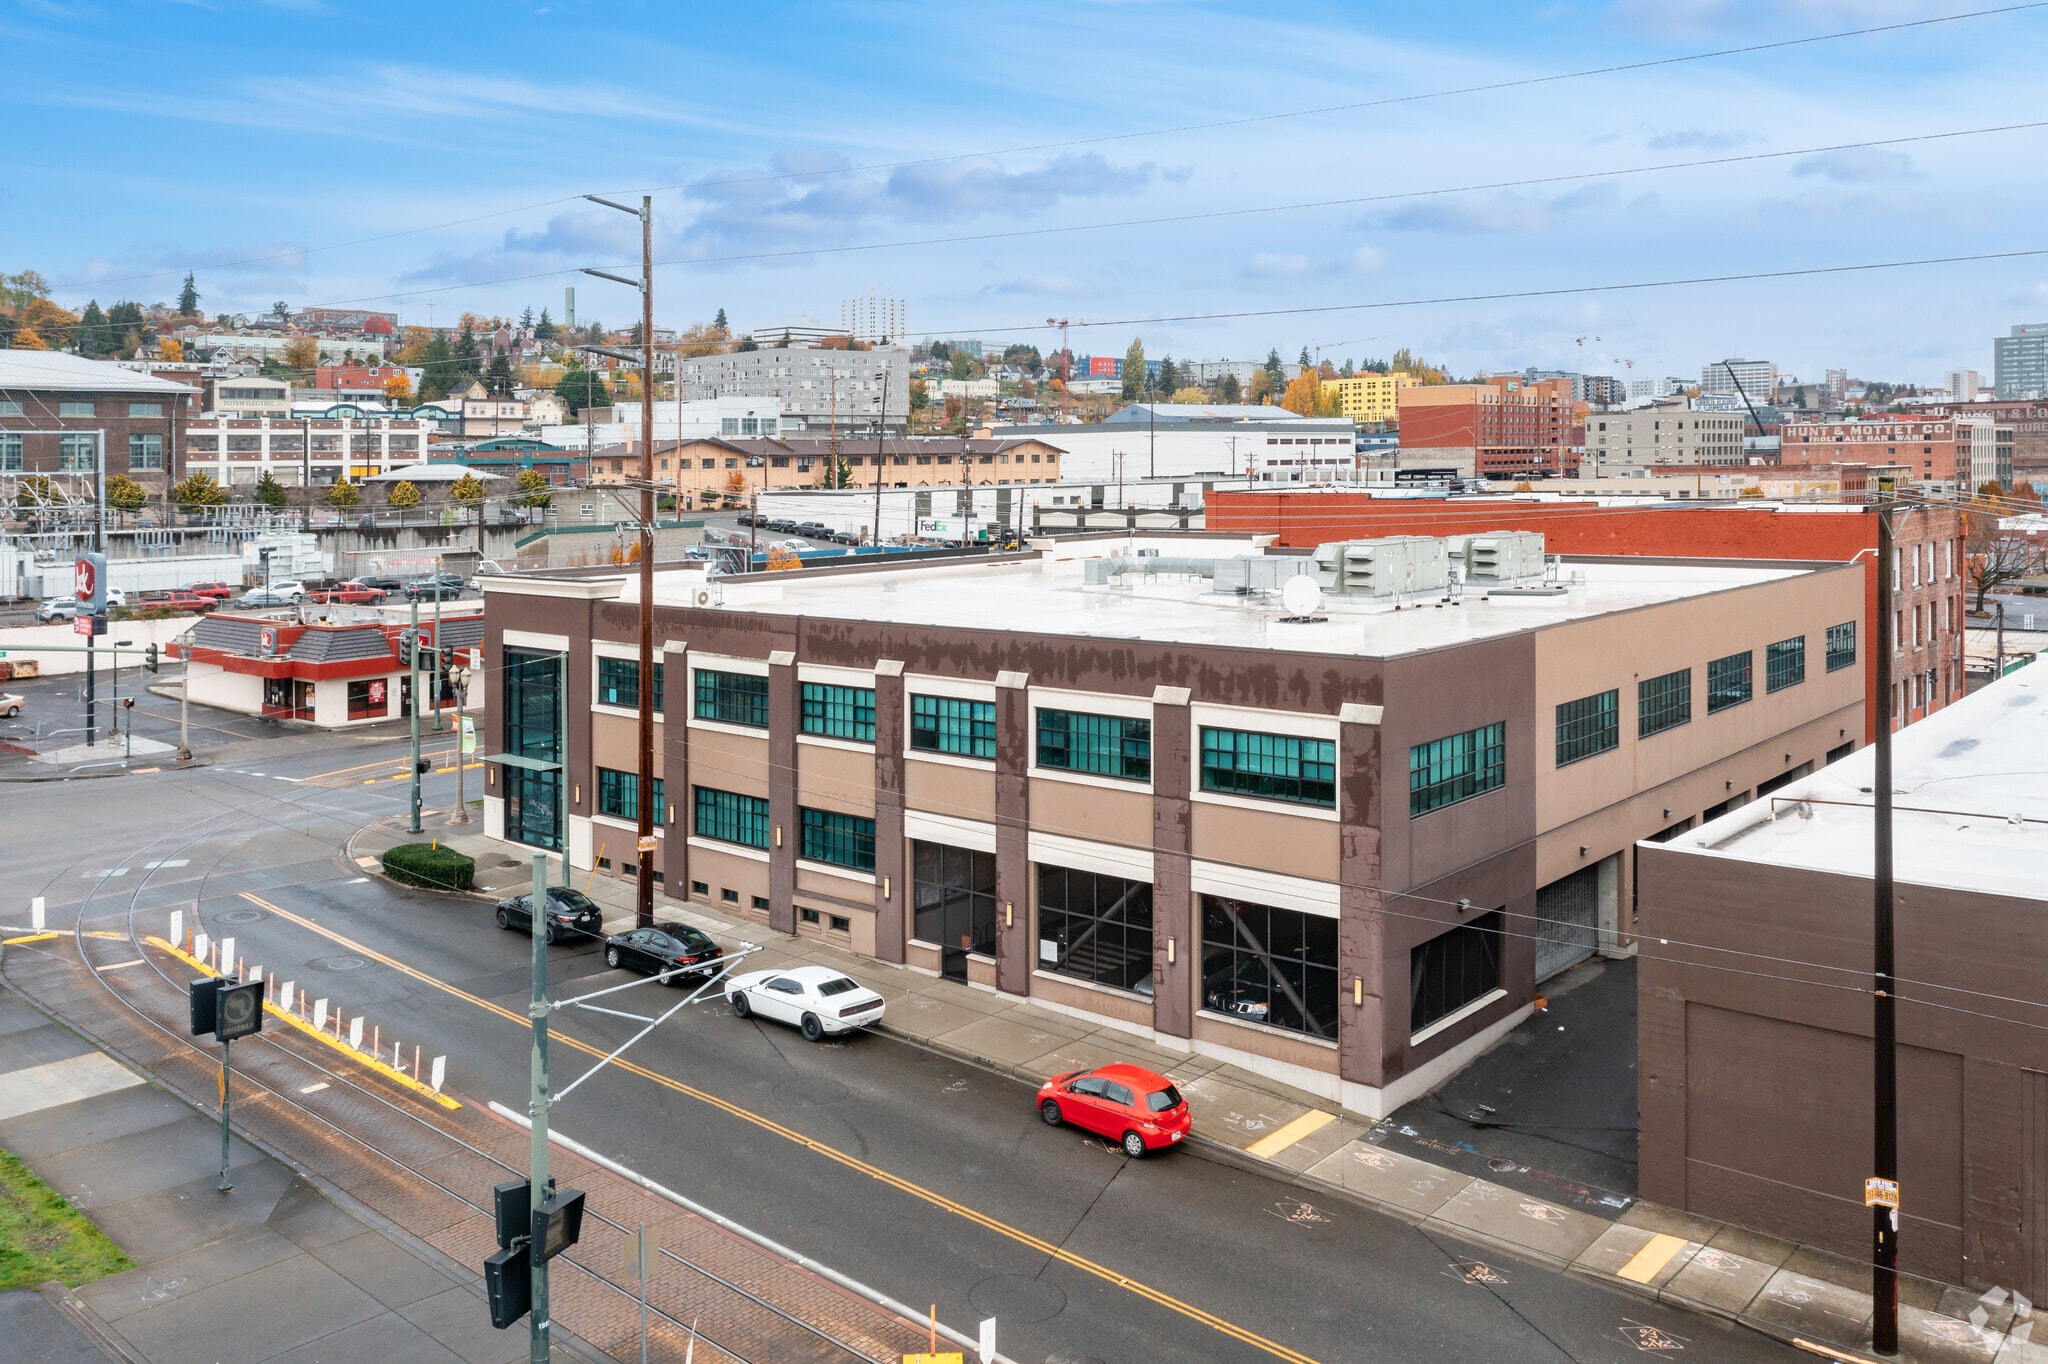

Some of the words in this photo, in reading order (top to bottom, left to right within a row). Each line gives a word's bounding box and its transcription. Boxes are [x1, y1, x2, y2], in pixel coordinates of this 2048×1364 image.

[1787, 426, 1829, 437] HUNT
[1834, 426, 1845, 436] &
[1850, 424, 1915, 435] MOTTET
[1922, 424, 1950, 434] CO.
[1807, 435, 1863, 443] HOLEALE
[1867, 434, 1925, 442] HARWARE
[920, 520, 948, 532] FedEx
[223, 1021, 253, 1036] DRIVEWAY
